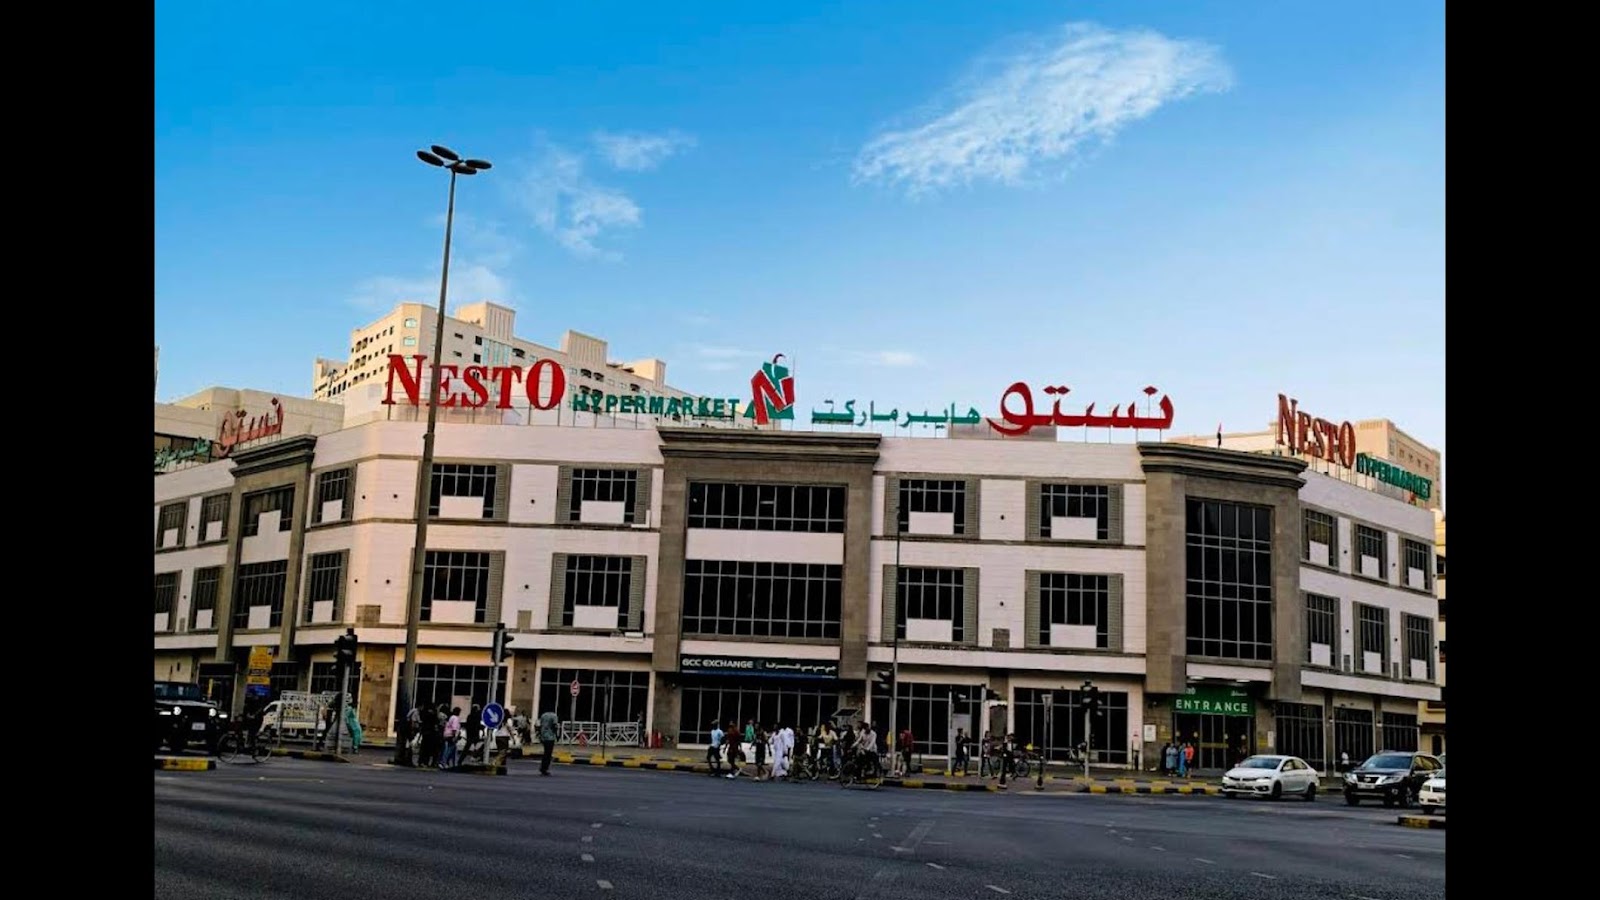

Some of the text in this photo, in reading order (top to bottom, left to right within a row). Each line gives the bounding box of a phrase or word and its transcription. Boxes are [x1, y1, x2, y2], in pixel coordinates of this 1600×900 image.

[381, 353, 741, 418] NESTO HYPERMARKET
[986, 380, 1175, 436] نستو
[1277, 393, 1356, 470] NESTO
[682, 658, 754, 669] GCC EXCHANGE
[1175, 699, 1249, 713] ENTRANCE
